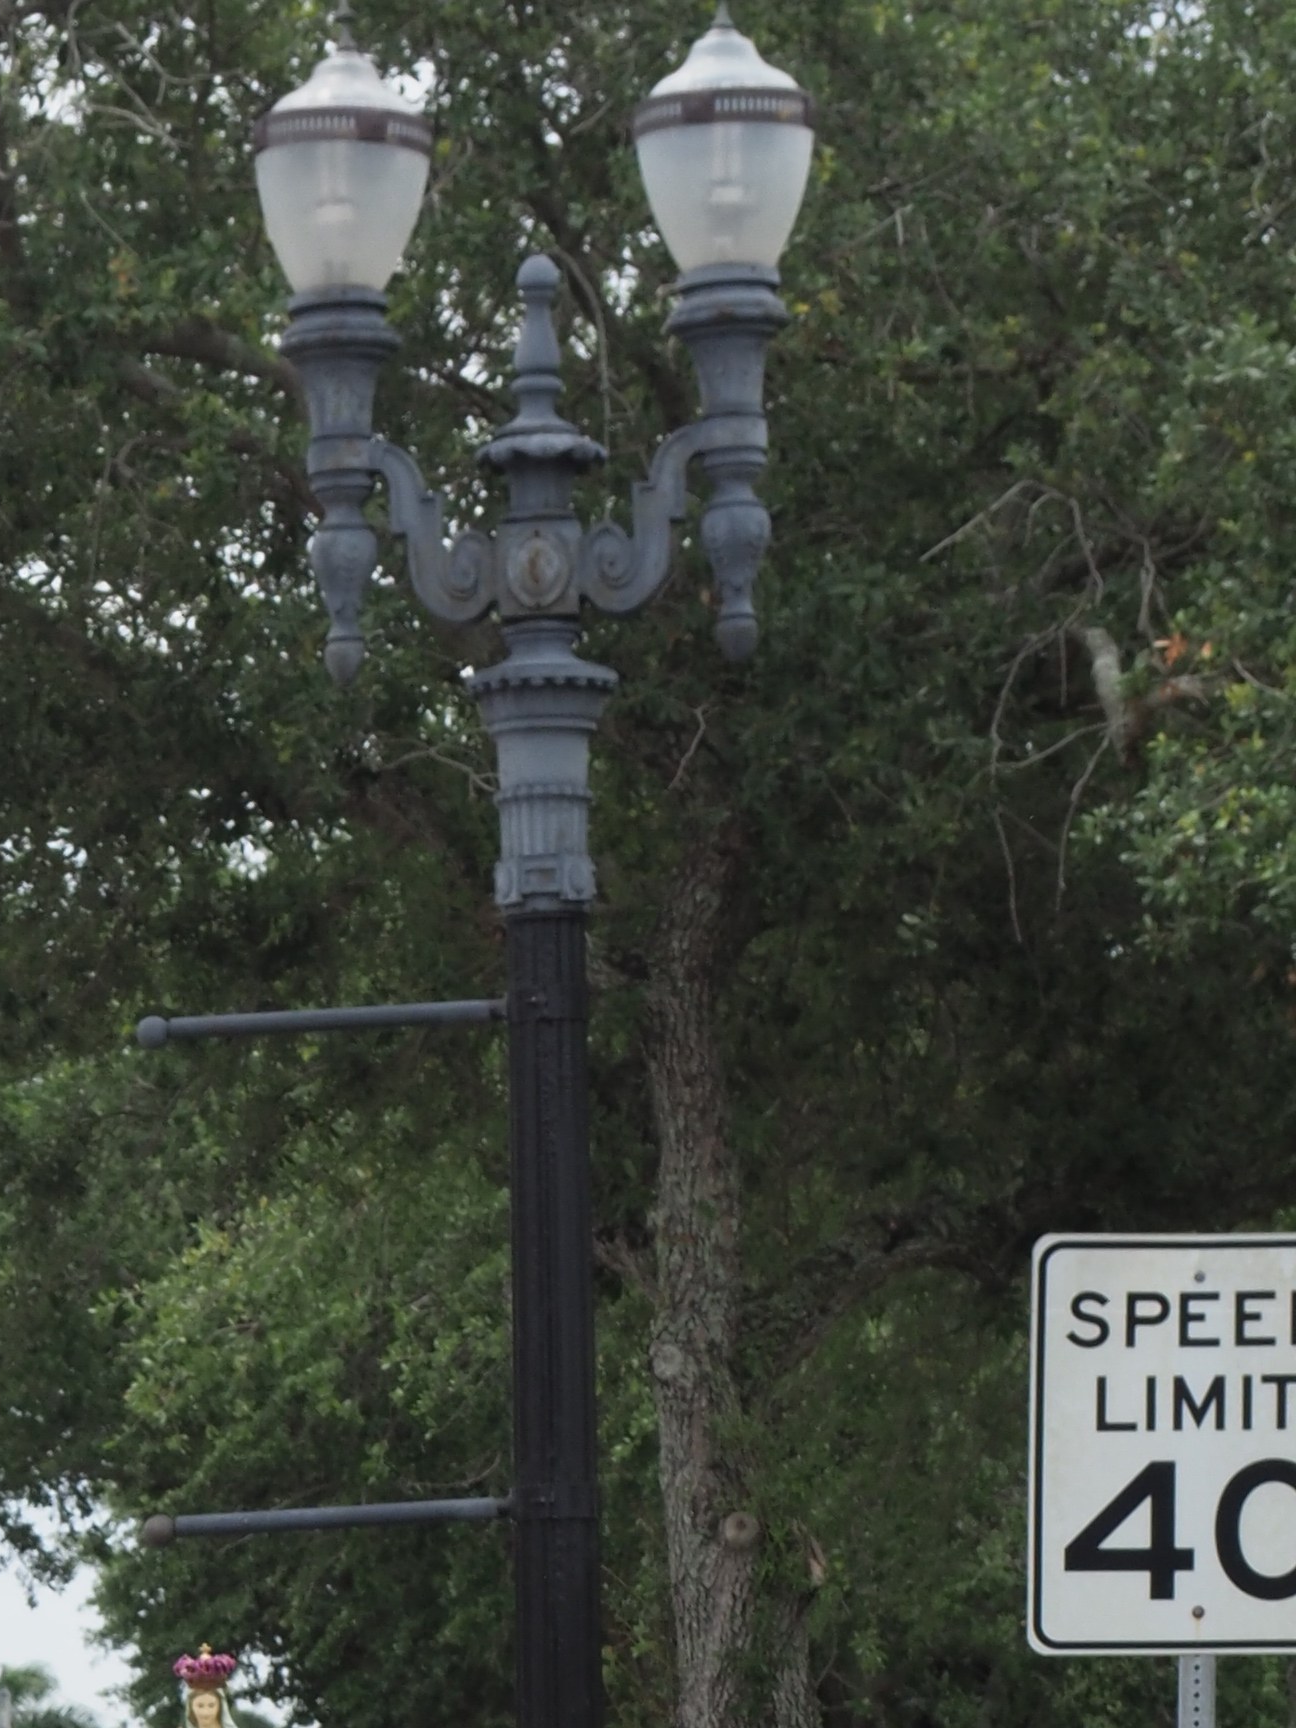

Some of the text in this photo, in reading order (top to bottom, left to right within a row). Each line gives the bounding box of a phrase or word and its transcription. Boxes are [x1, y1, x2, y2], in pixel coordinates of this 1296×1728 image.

[1066, 1290, 1296, 1348] SPEE
[1096, 1375, 1296, 1432] LIMIT
[1064, 1457, 1296, 1602] 40
